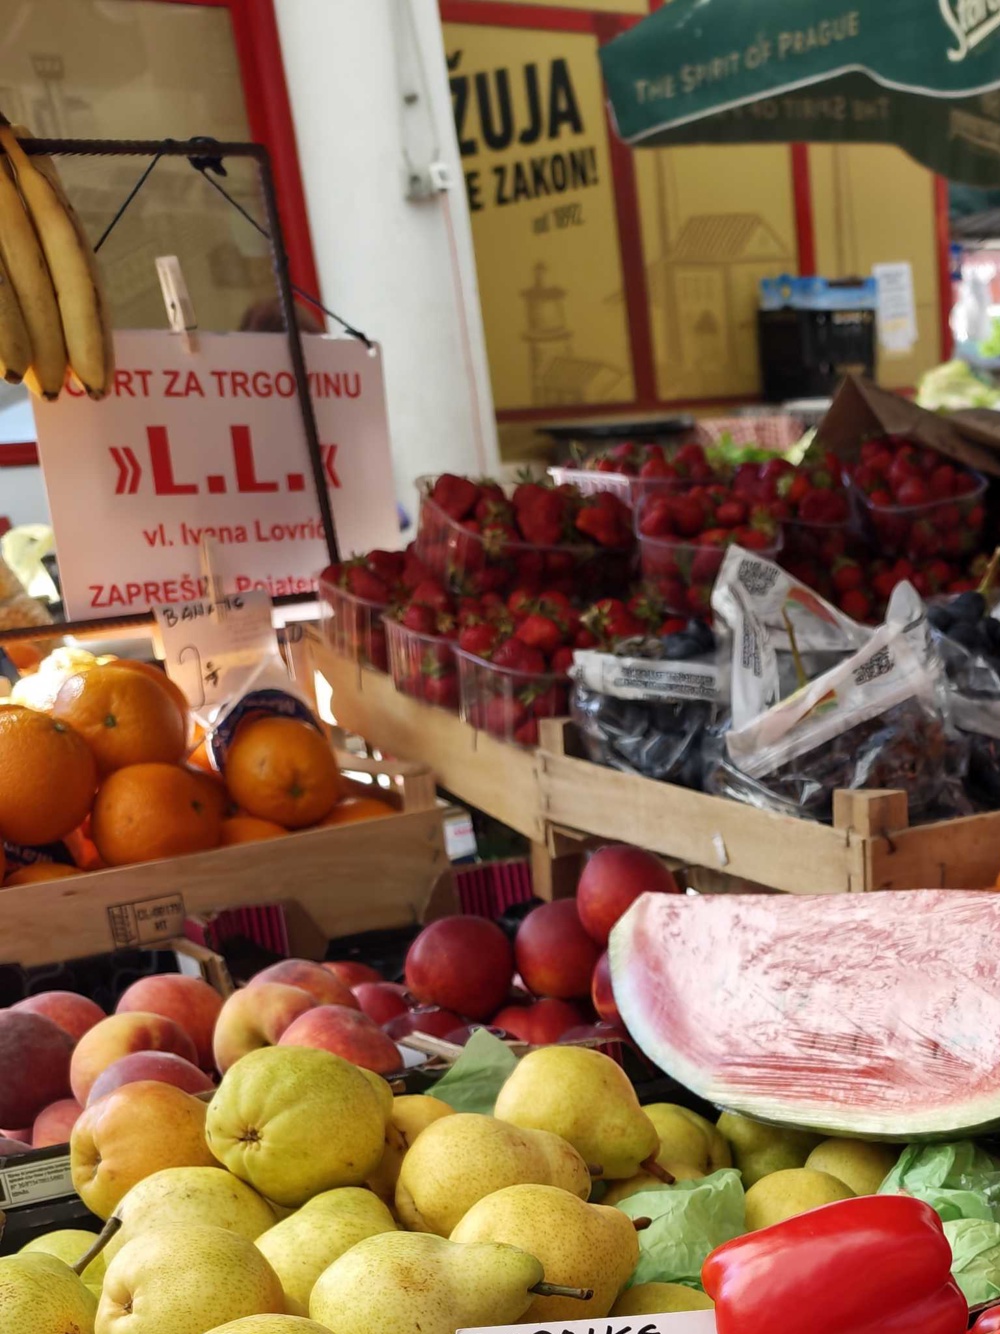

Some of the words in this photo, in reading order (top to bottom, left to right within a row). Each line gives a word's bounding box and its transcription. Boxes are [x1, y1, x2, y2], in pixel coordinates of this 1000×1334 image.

[634, 77, 675, 106] THE
[680, 52, 740, 90] SPIRIT
[744, 39, 770, 68] OF
[777, 11, 861, 58] PRAGUE
[464, 170, 485, 212] E
[491, 147, 599, 207] ZAKON!
[65, 369, 152, 399] RT
[163, 370, 204, 398] ZA
[211, 370, 362, 399] TRGOINU
[142, 523, 174, 548] vl.
[89, 573, 208, 609] ZAPREŠI
